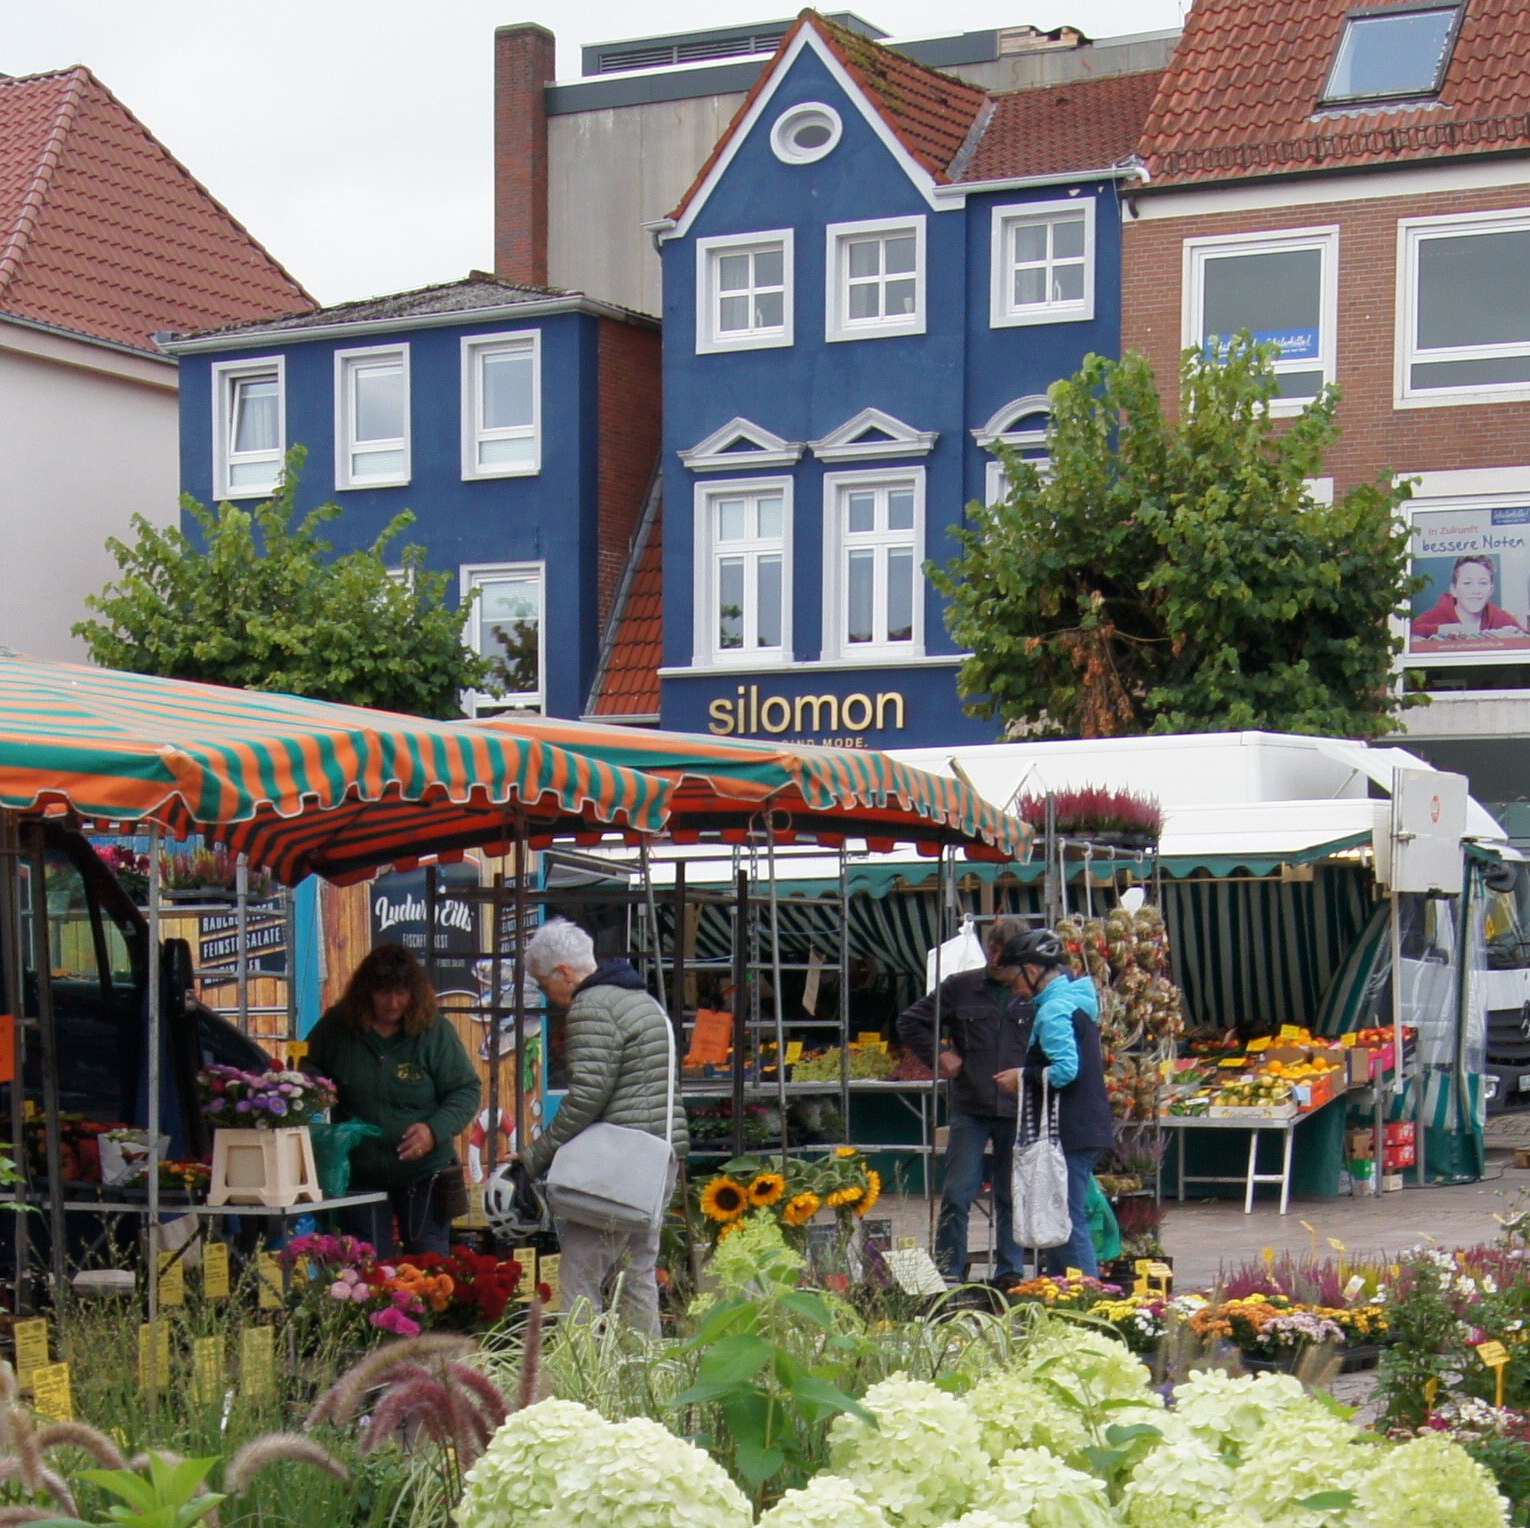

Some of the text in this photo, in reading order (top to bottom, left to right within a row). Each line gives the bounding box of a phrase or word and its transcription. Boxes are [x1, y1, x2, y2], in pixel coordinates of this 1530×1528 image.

[1422, 534, 1526, 553] bessere Noten
[708, 684, 905, 736] silomon
[822, 736, 869, 748] MODE.
